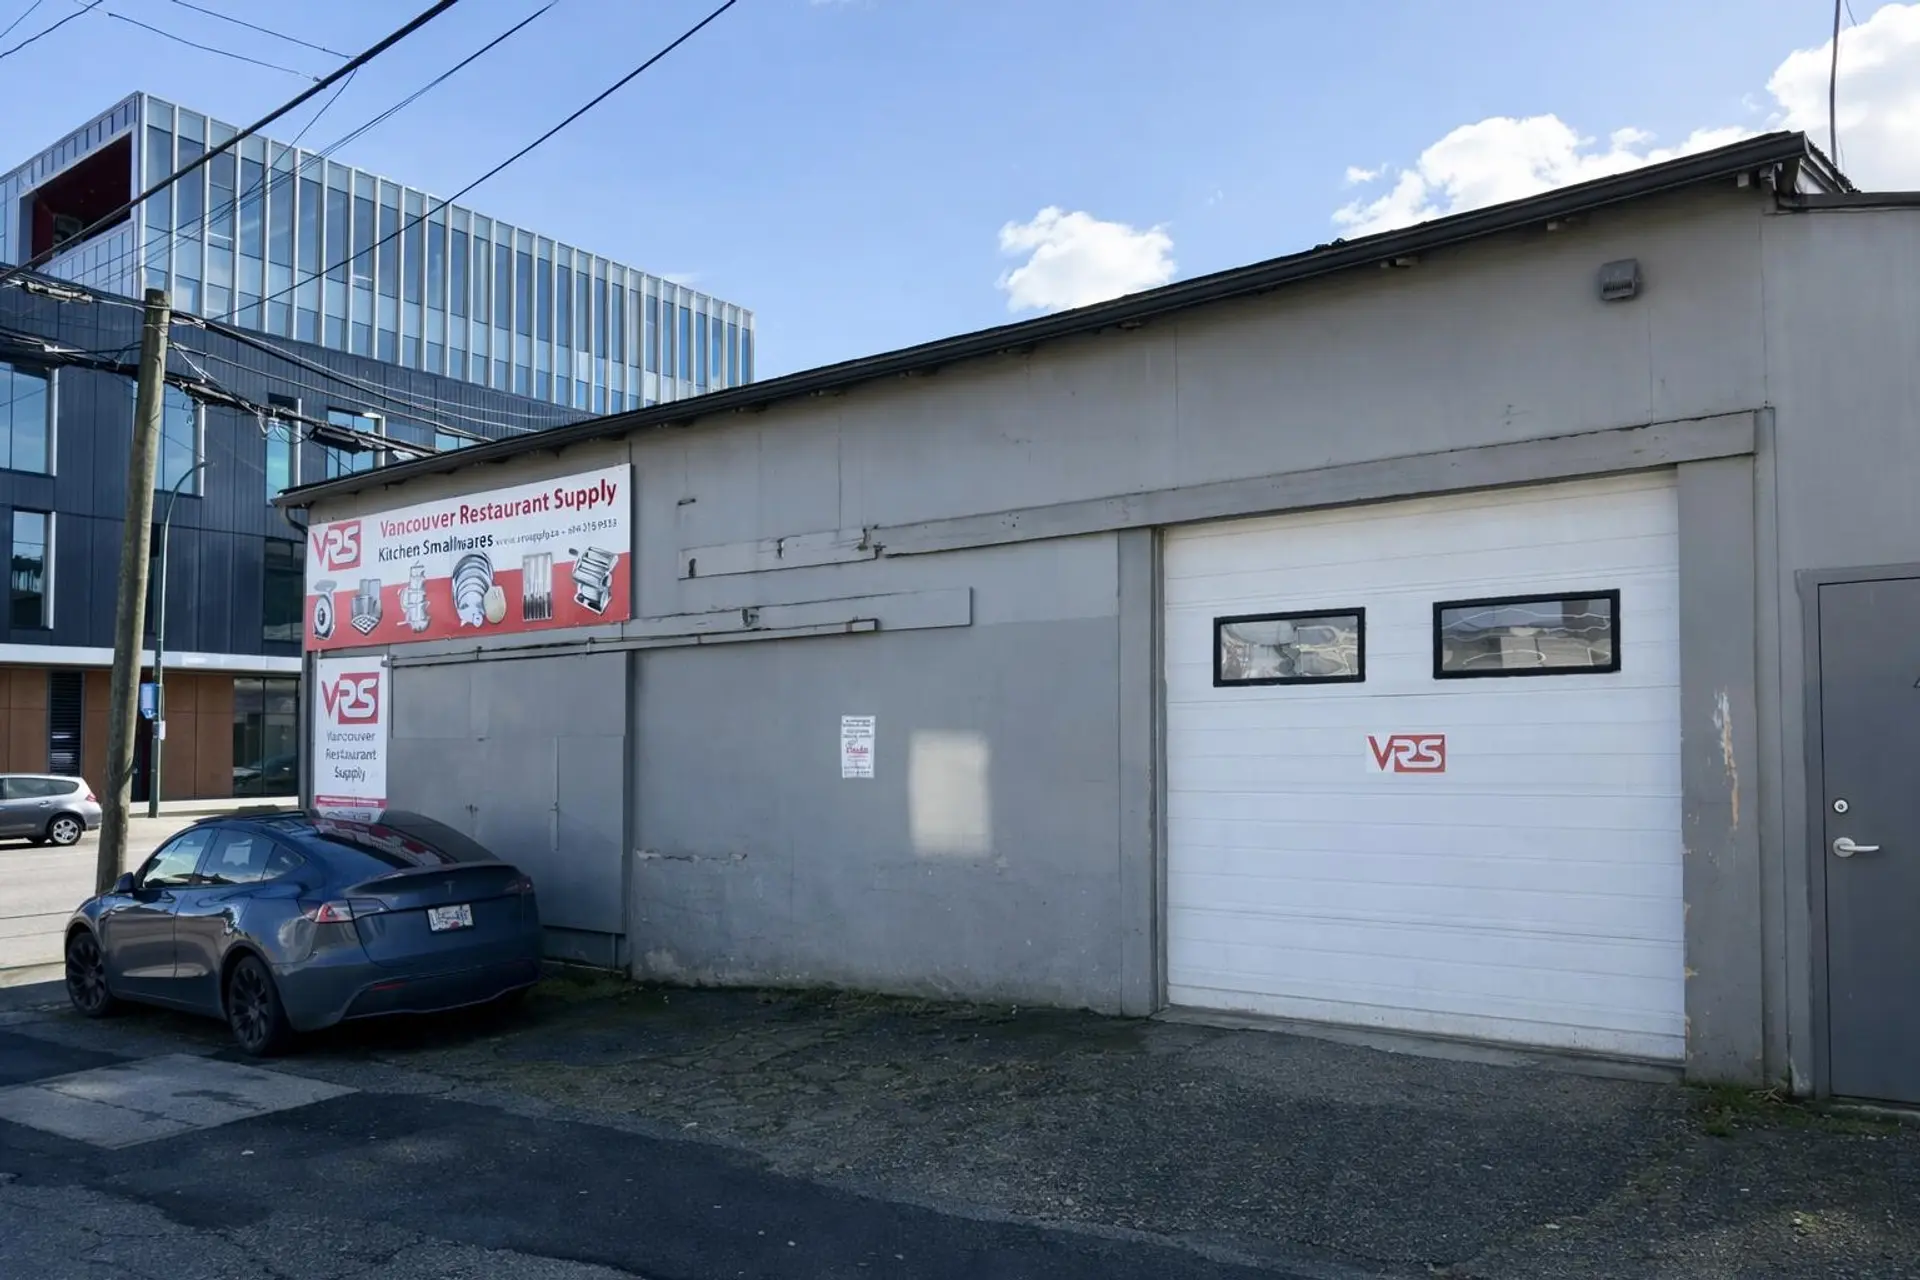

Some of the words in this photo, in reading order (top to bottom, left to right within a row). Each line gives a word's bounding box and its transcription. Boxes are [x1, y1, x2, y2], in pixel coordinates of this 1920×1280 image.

[380, 512, 456, 538] Vancouver
[460, 493, 549, 525] Restaurant
[554, 479, 617, 511] Supply
[312, 521, 361, 570] VRS
[379, 544, 420, 562] Kitchen
[423, 535, 494, 555] Smallwares
[322, 672, 379, 724] VRS
[327, 731, 376, 743] Vancouver
[1368, 734, 1446, 773] VRS
[325, 748, 377, 761] Restaurant
[334, 767, 366, 782] Supply
